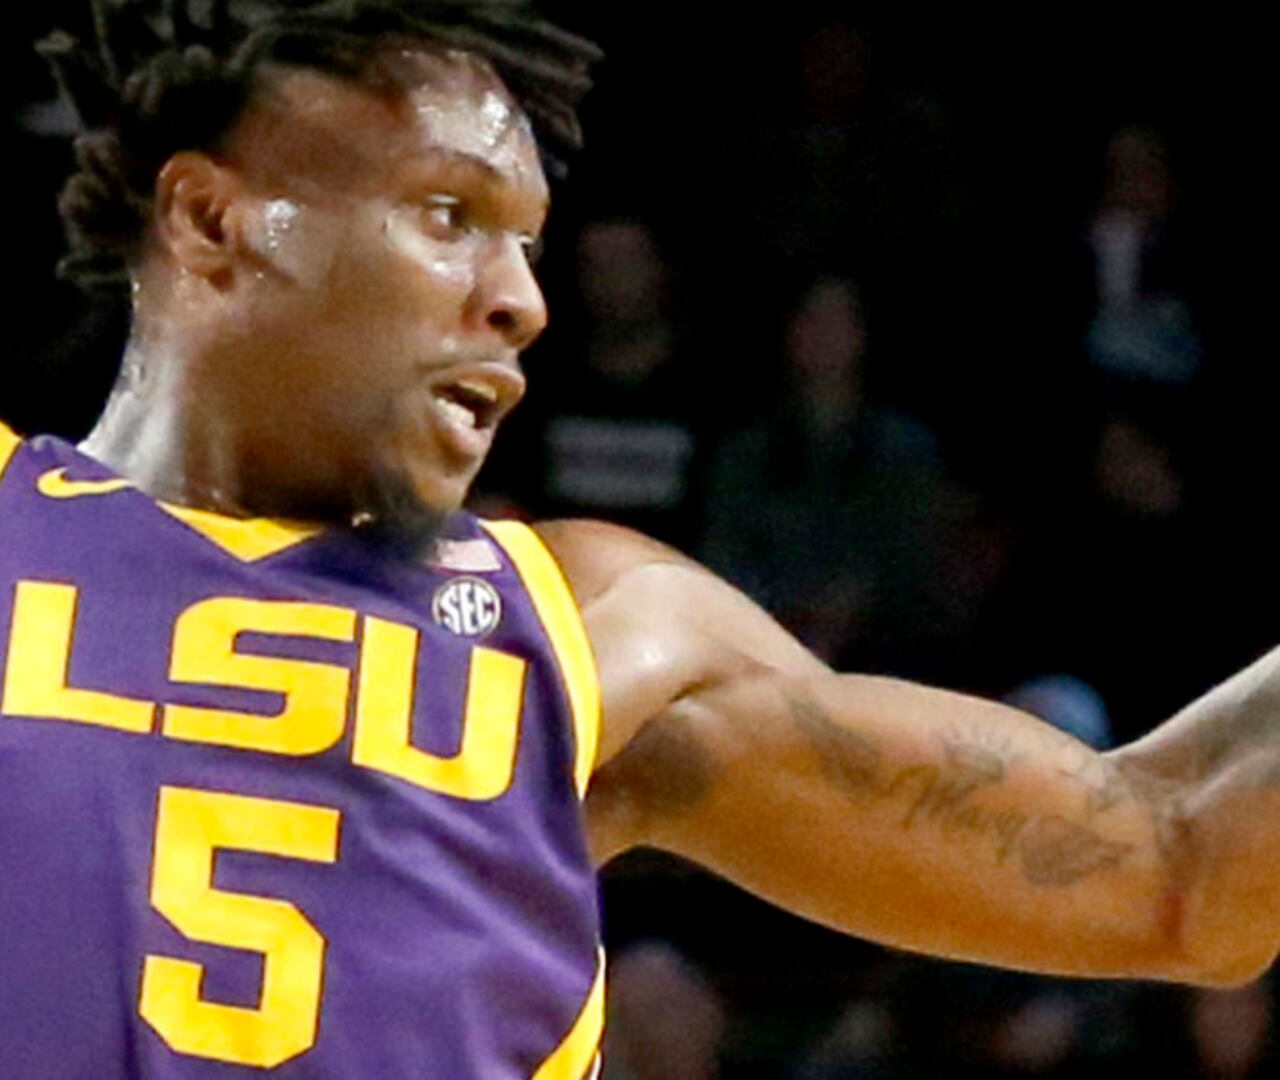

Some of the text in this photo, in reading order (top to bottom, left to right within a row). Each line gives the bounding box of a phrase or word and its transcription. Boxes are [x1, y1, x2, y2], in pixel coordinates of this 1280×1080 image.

[0, 579, 529, 802] LSU
[439, 581, 496, 635] SEC
[137, 784, 342, 1070] 5
